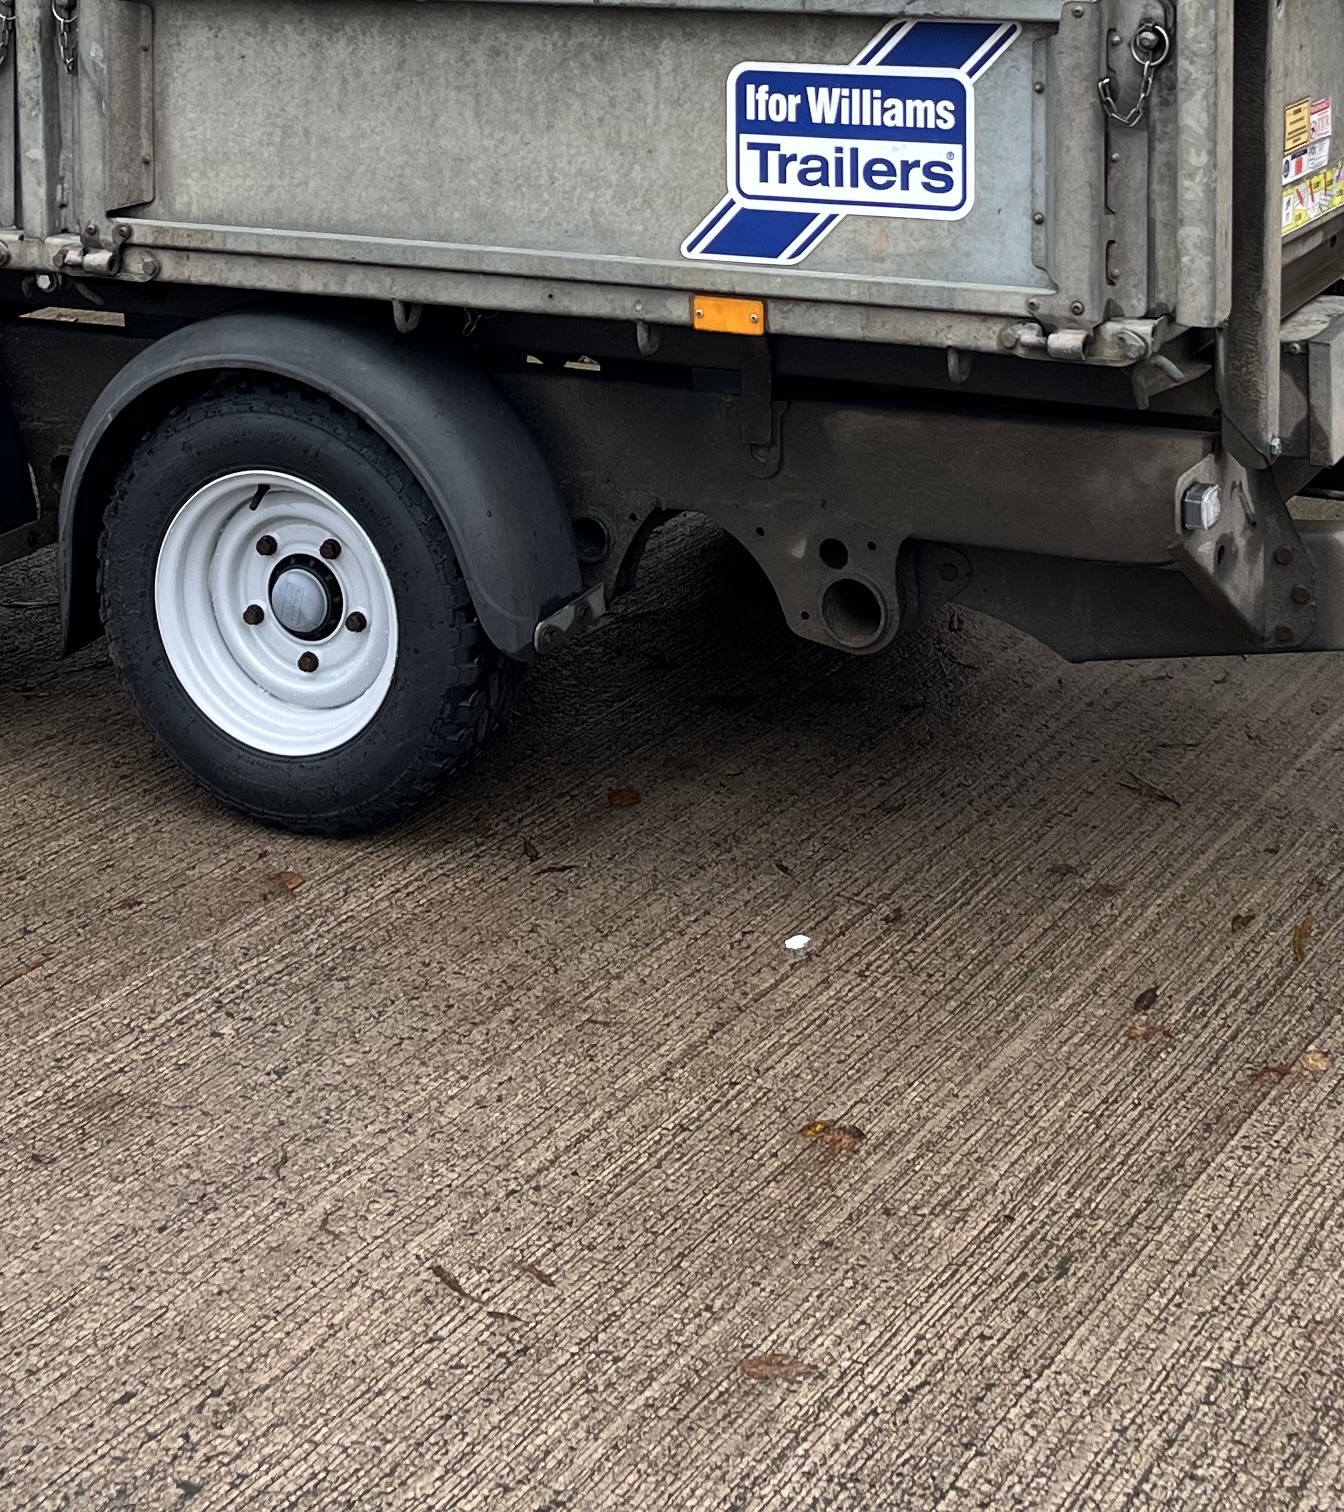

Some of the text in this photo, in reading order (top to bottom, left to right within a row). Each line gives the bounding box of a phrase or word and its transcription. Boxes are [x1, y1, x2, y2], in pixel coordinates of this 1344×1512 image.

[745, 83, 956, 130] Ifor Williams
[746, 141, 955, 194] Trailers
